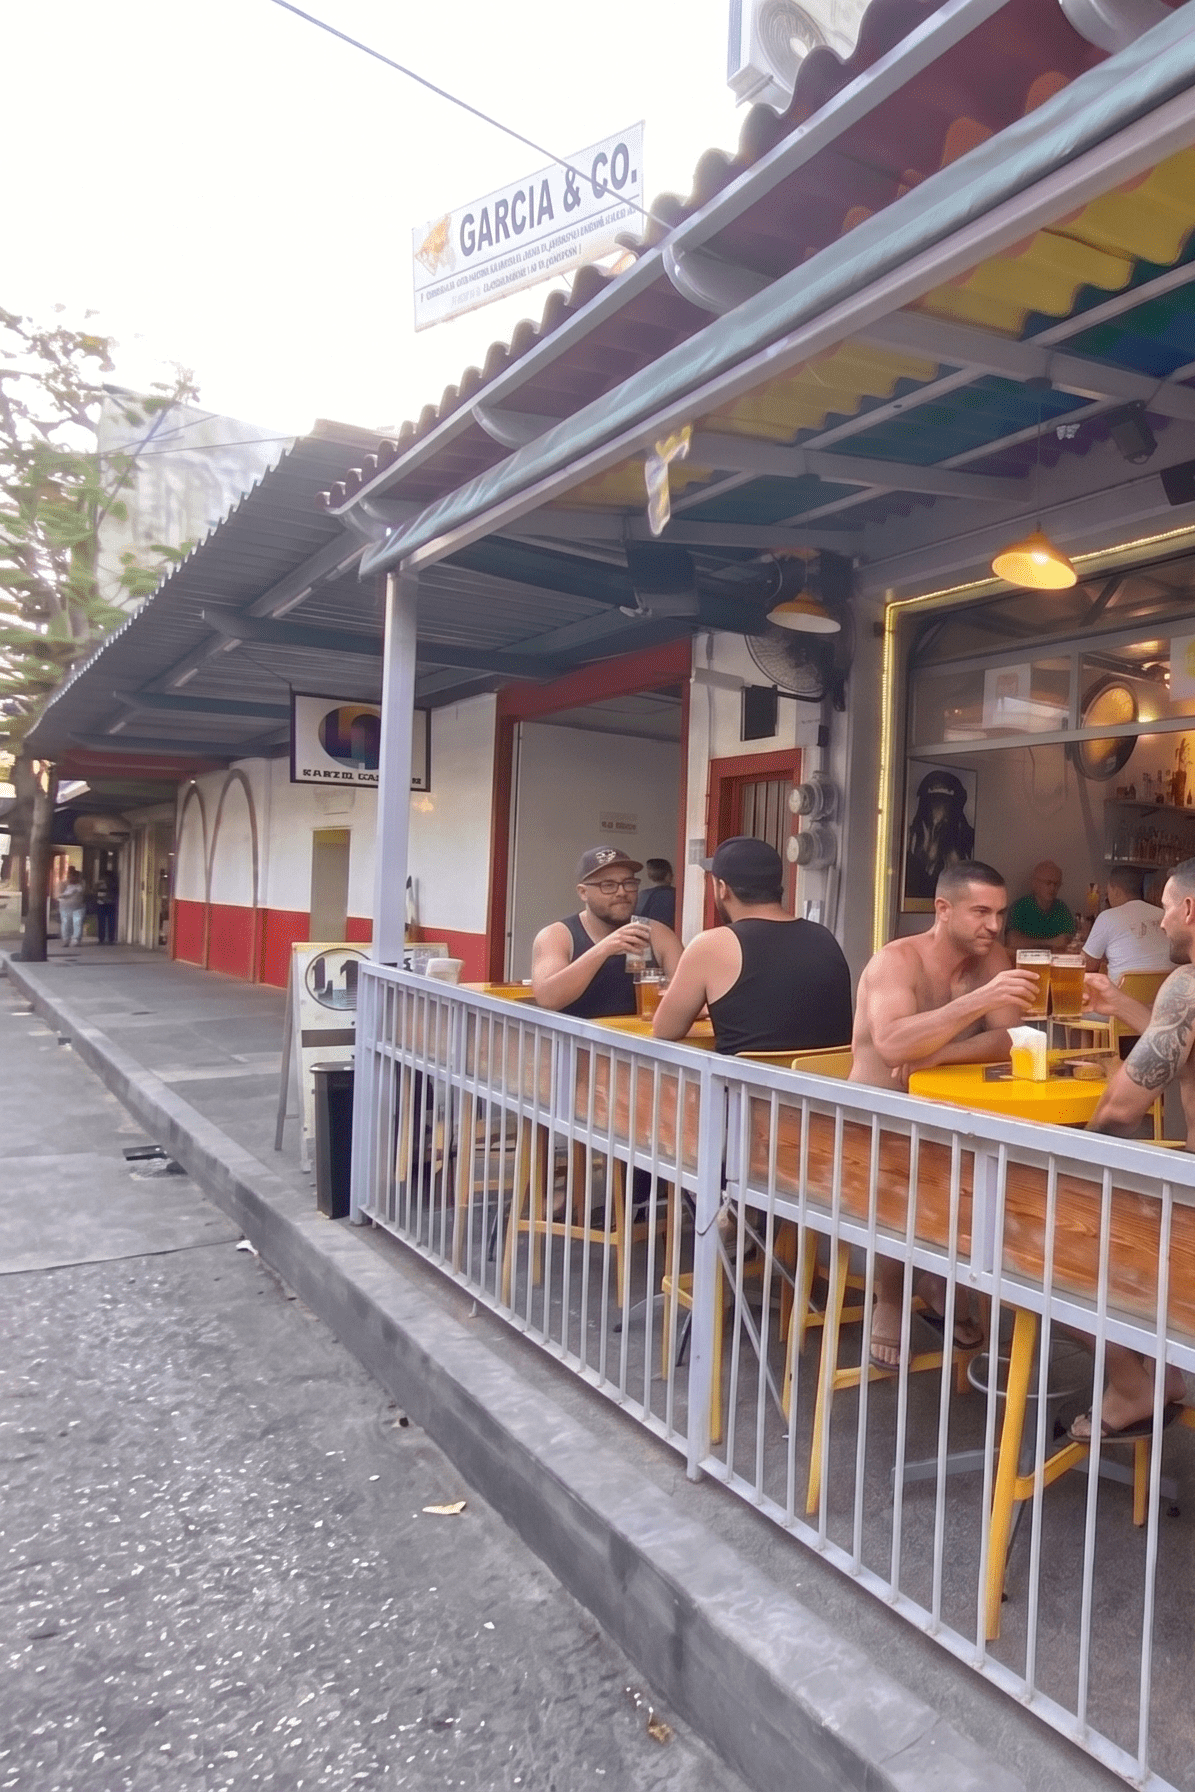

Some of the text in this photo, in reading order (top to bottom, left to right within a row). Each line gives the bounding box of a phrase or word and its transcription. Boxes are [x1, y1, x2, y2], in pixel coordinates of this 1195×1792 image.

[459, 178, 555, 257] GARCIA
[563, 167, 581, 213] &
[591, 142, 638, 200] CO.
